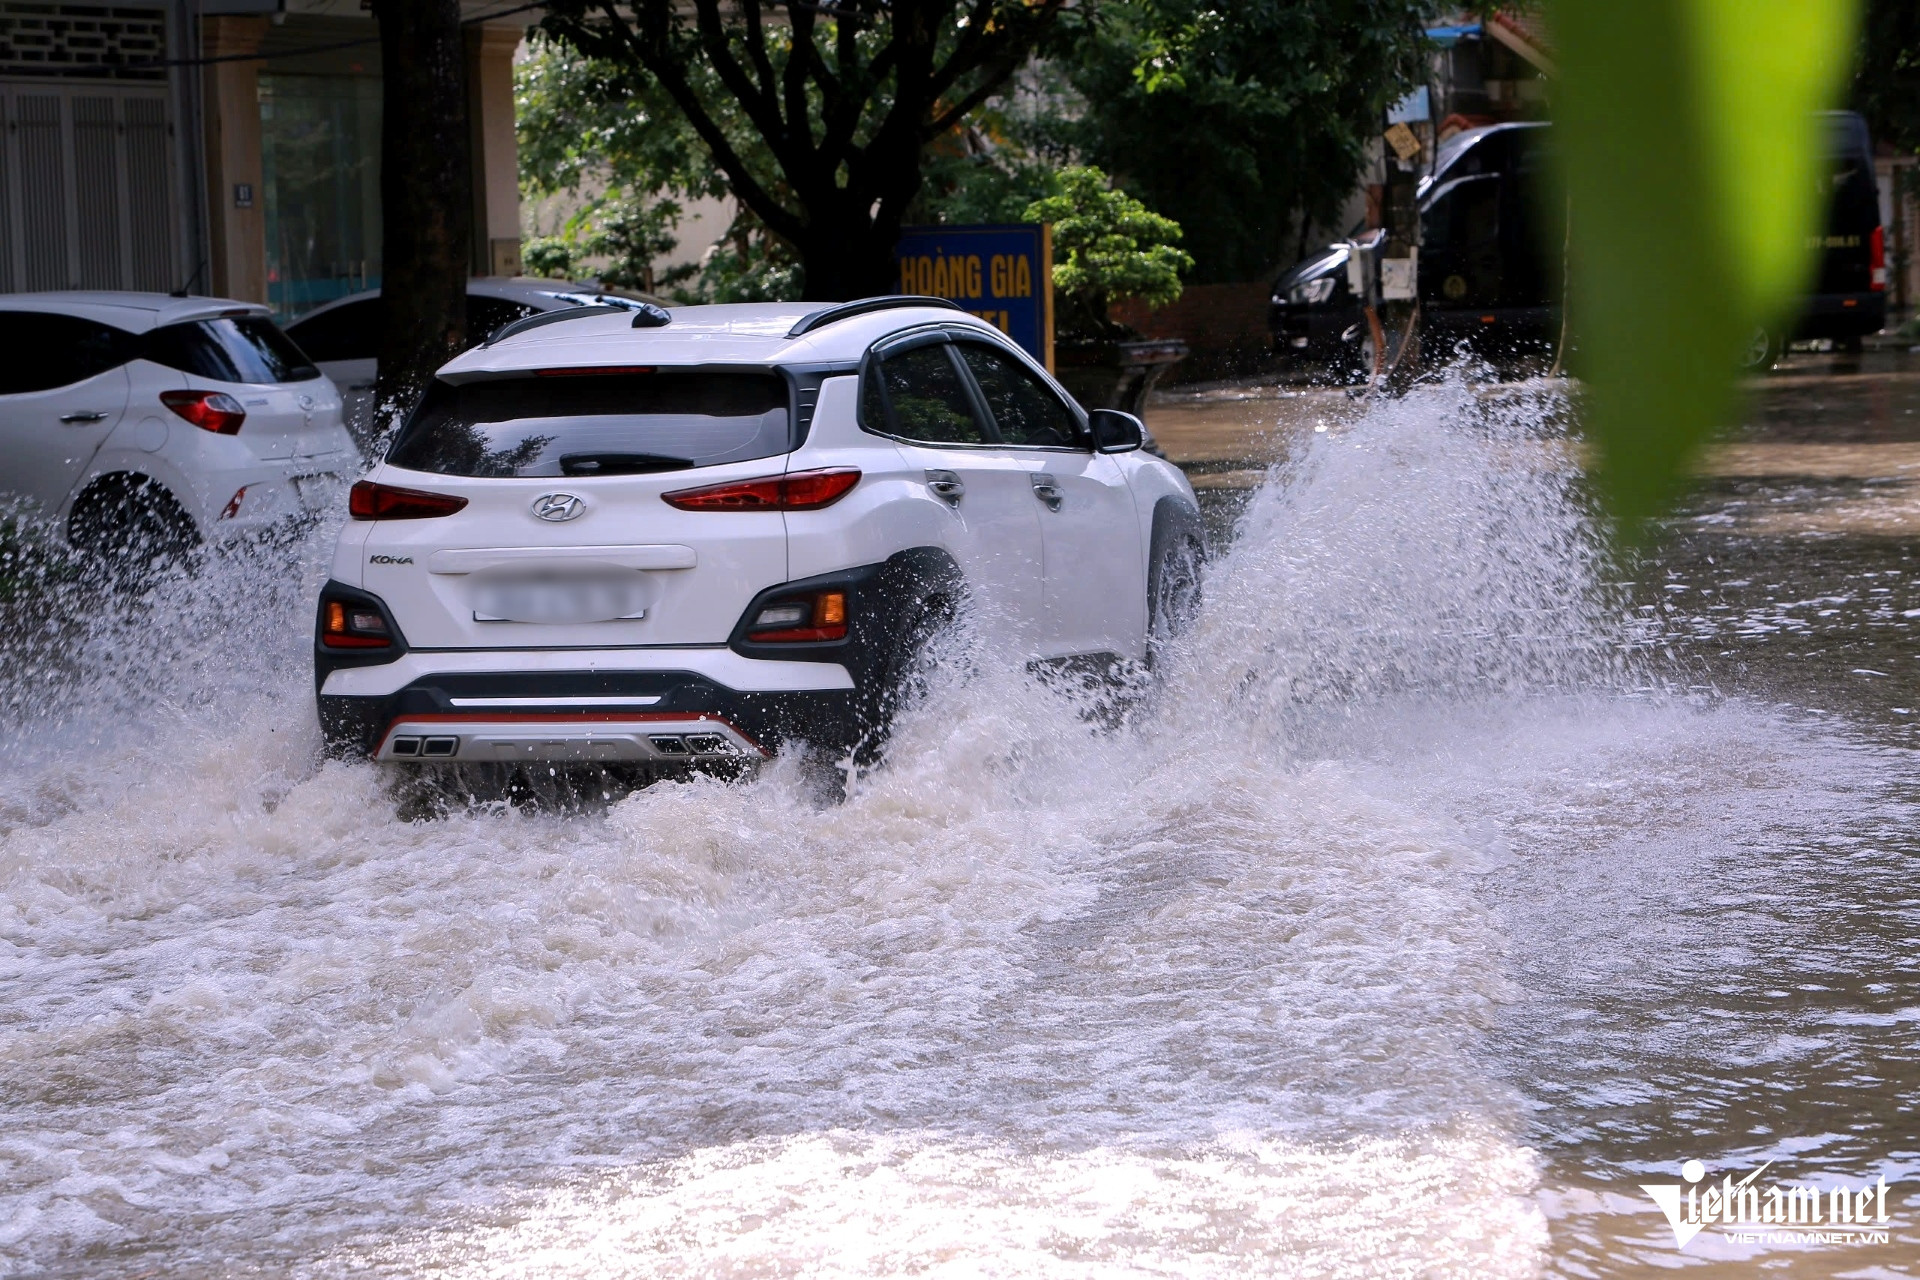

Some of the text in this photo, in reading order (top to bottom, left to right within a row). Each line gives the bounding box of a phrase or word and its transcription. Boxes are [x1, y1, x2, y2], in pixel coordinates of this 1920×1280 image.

[901, 246, 1031, 298] HOÀNG GIA
[369, 554, 415, 565] KONA
